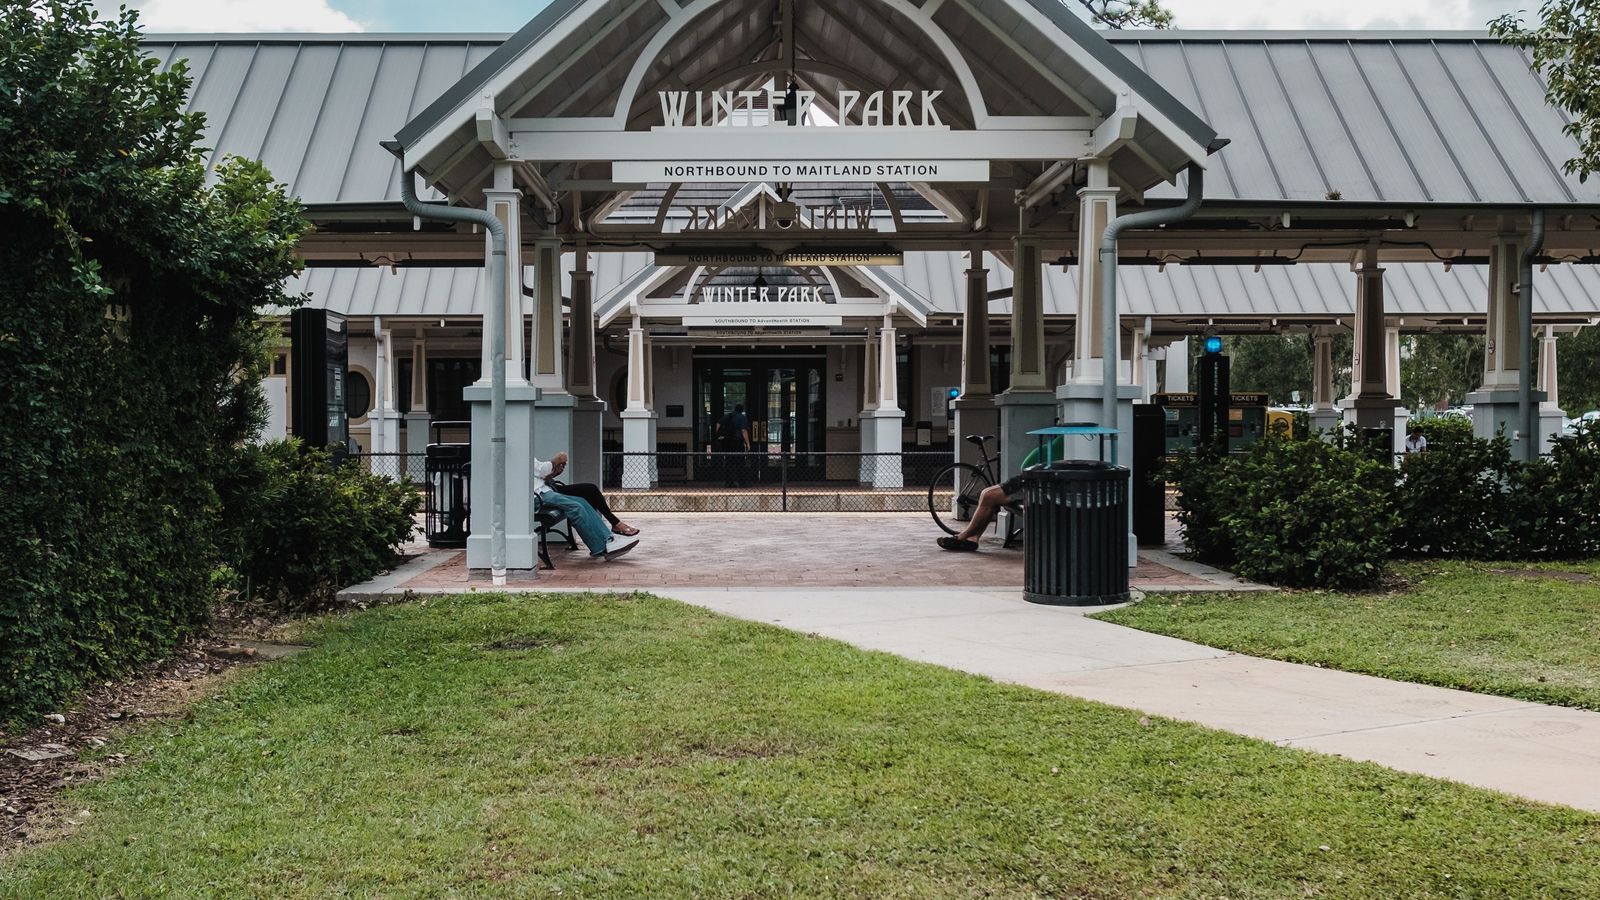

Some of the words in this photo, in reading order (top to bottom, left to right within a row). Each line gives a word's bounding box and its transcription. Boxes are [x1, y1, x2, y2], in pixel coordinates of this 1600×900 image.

[658, 90, 816, 127] WINTER
[838, 90, 943, 127] PARK
[664, 165, 768, 176] NORTHBOUND
[773, 165, 791, 176] TO
[796, 165, 872, 176] MAITLAND
[876, 165, 938, 176] STATION
[688, 254, 757, 263] NORTHBOUND
[760, 254, 773, 263] TO
[776, 254, 826, 263] MAITLAND
[829, 254, 870, 263] STATION
[702, 286, 769, 302] WINTER
[778, 286, 823, 302] PARK
